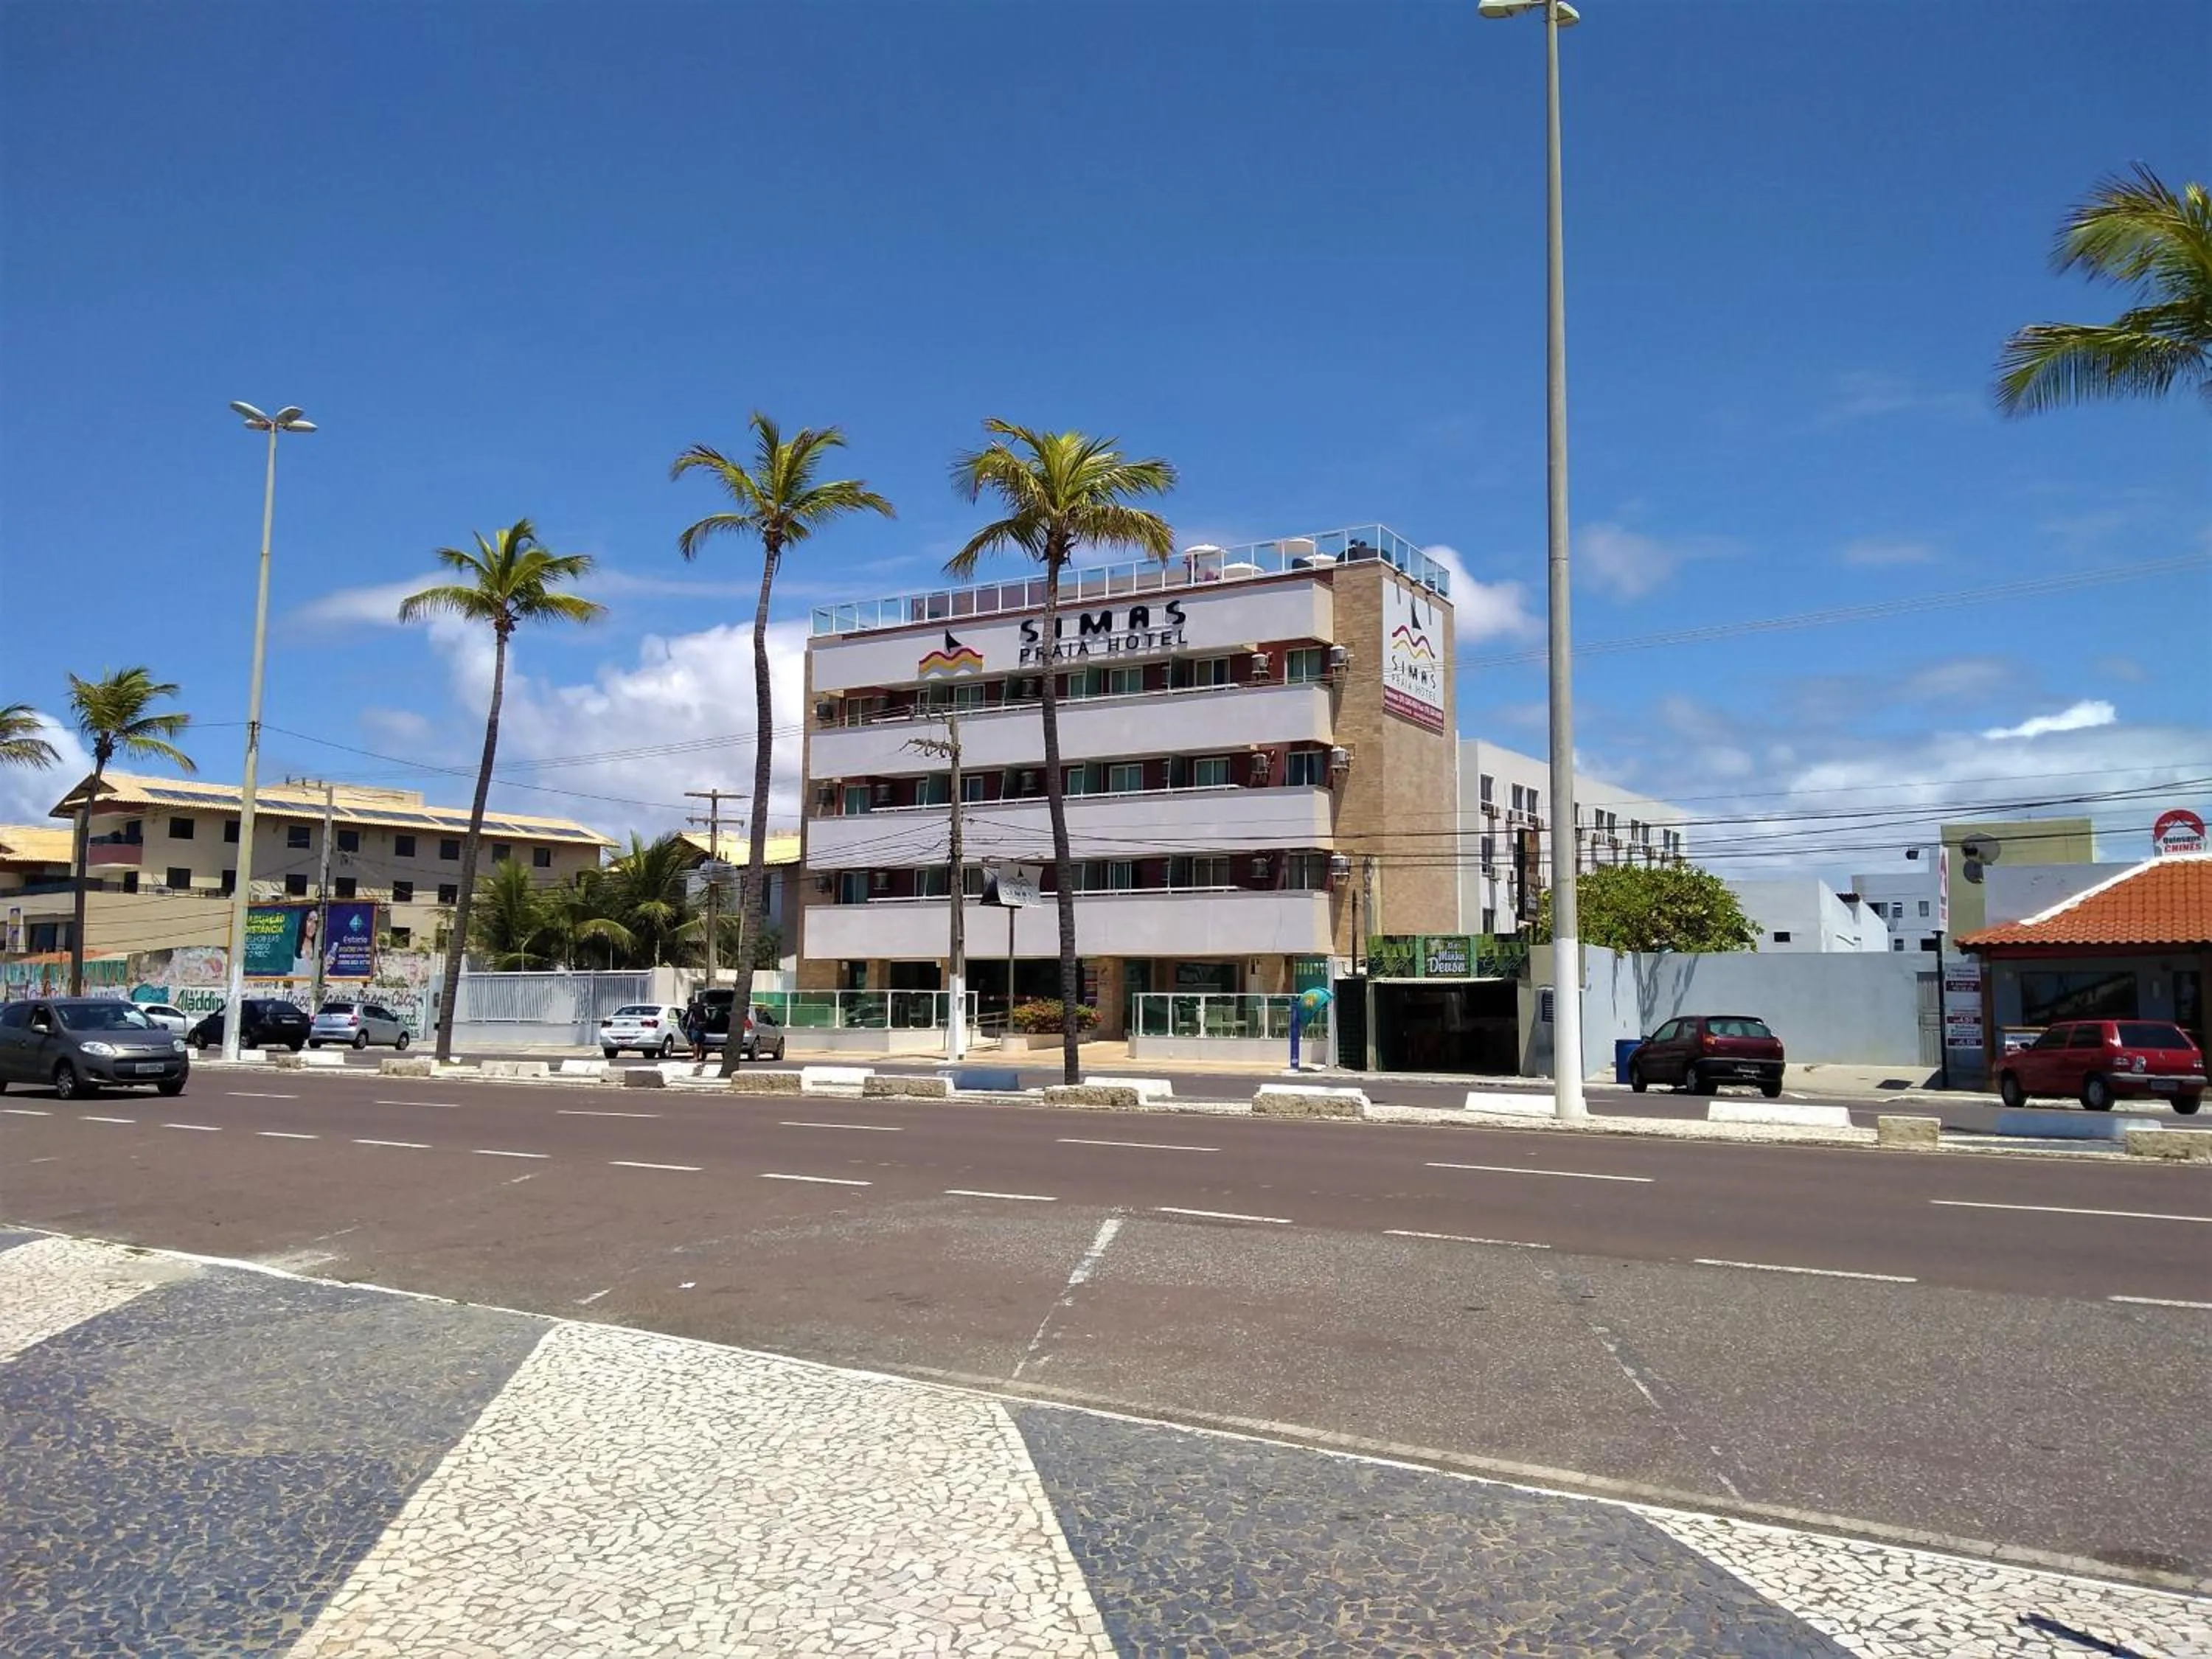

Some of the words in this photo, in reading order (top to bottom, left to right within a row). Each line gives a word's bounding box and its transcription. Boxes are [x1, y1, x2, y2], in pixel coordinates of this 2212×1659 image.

[1020, 600, 1186, 642] SIMAS
[1020, 641, 1089, 662] PRAIA
[1107, 630, 1187, 652] HOTEL
[1391, 655, 1436, 689] SIMAS
[1415, 686, 1437, 703] HOTEL
[1427, 956, 1465, 973] Deusa
